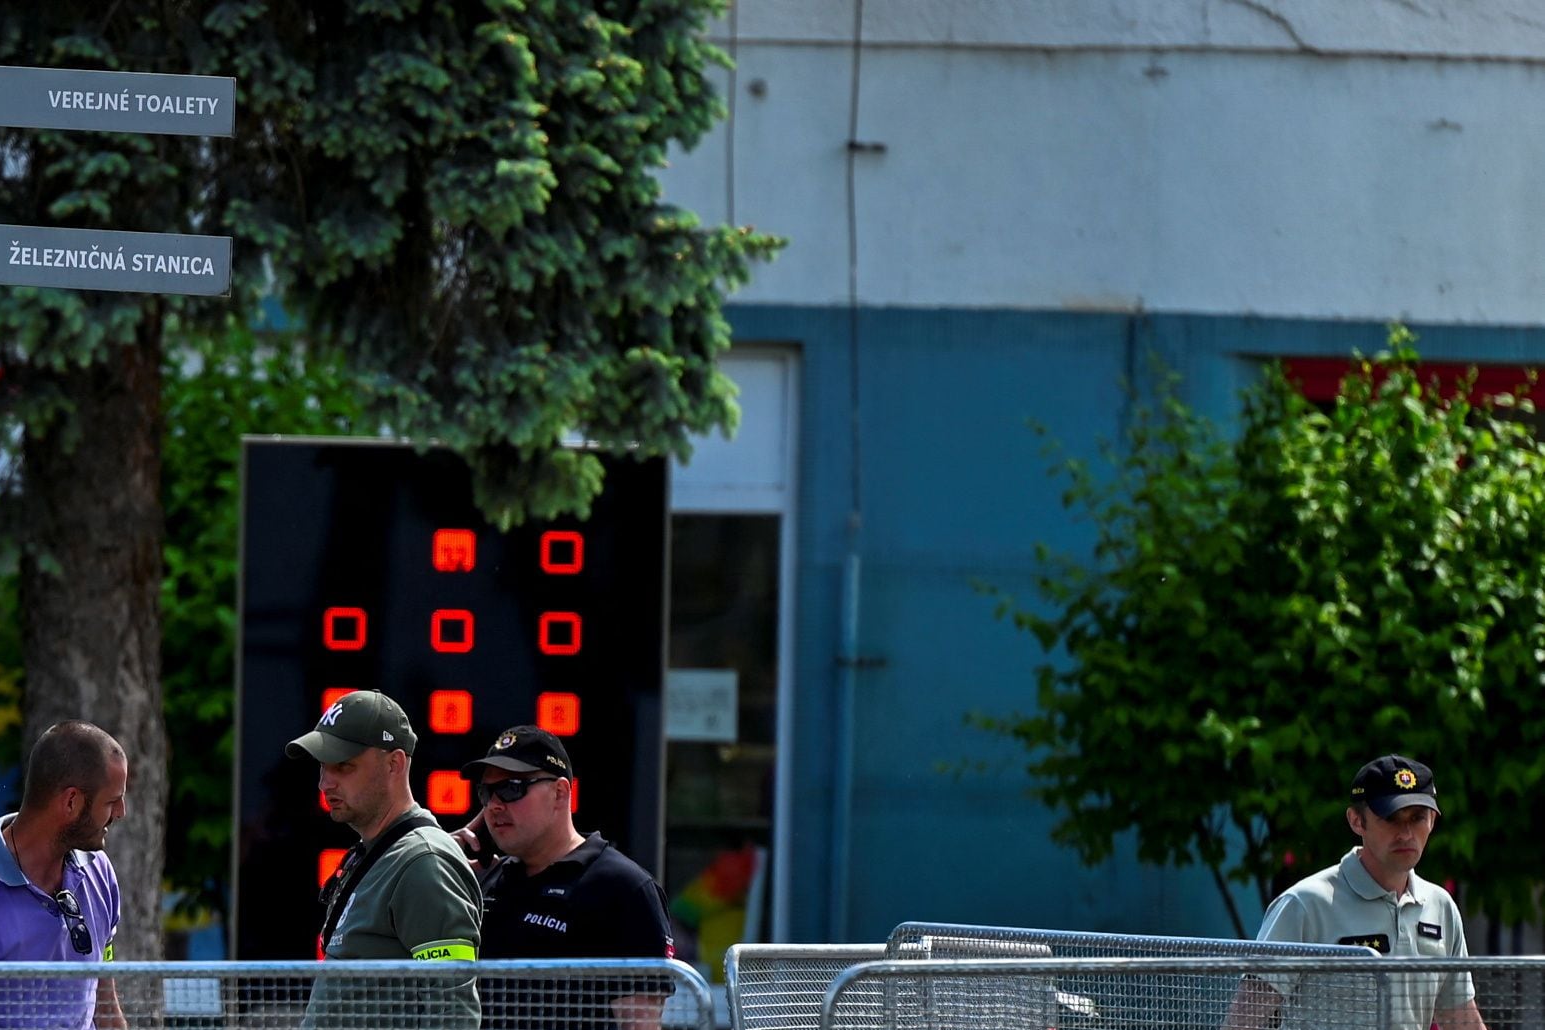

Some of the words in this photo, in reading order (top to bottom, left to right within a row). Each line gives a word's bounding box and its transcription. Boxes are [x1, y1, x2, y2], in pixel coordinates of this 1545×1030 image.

[47, 88, 130, 112] VEREJNÉ
[134, 94, 219, 116] TOALETY
[8, 240, 127, 272] ŽELEZNIČNÁ
[131, 253, 215, 276] STANICA
[523, 912, 568, 934] POLÍCIA
